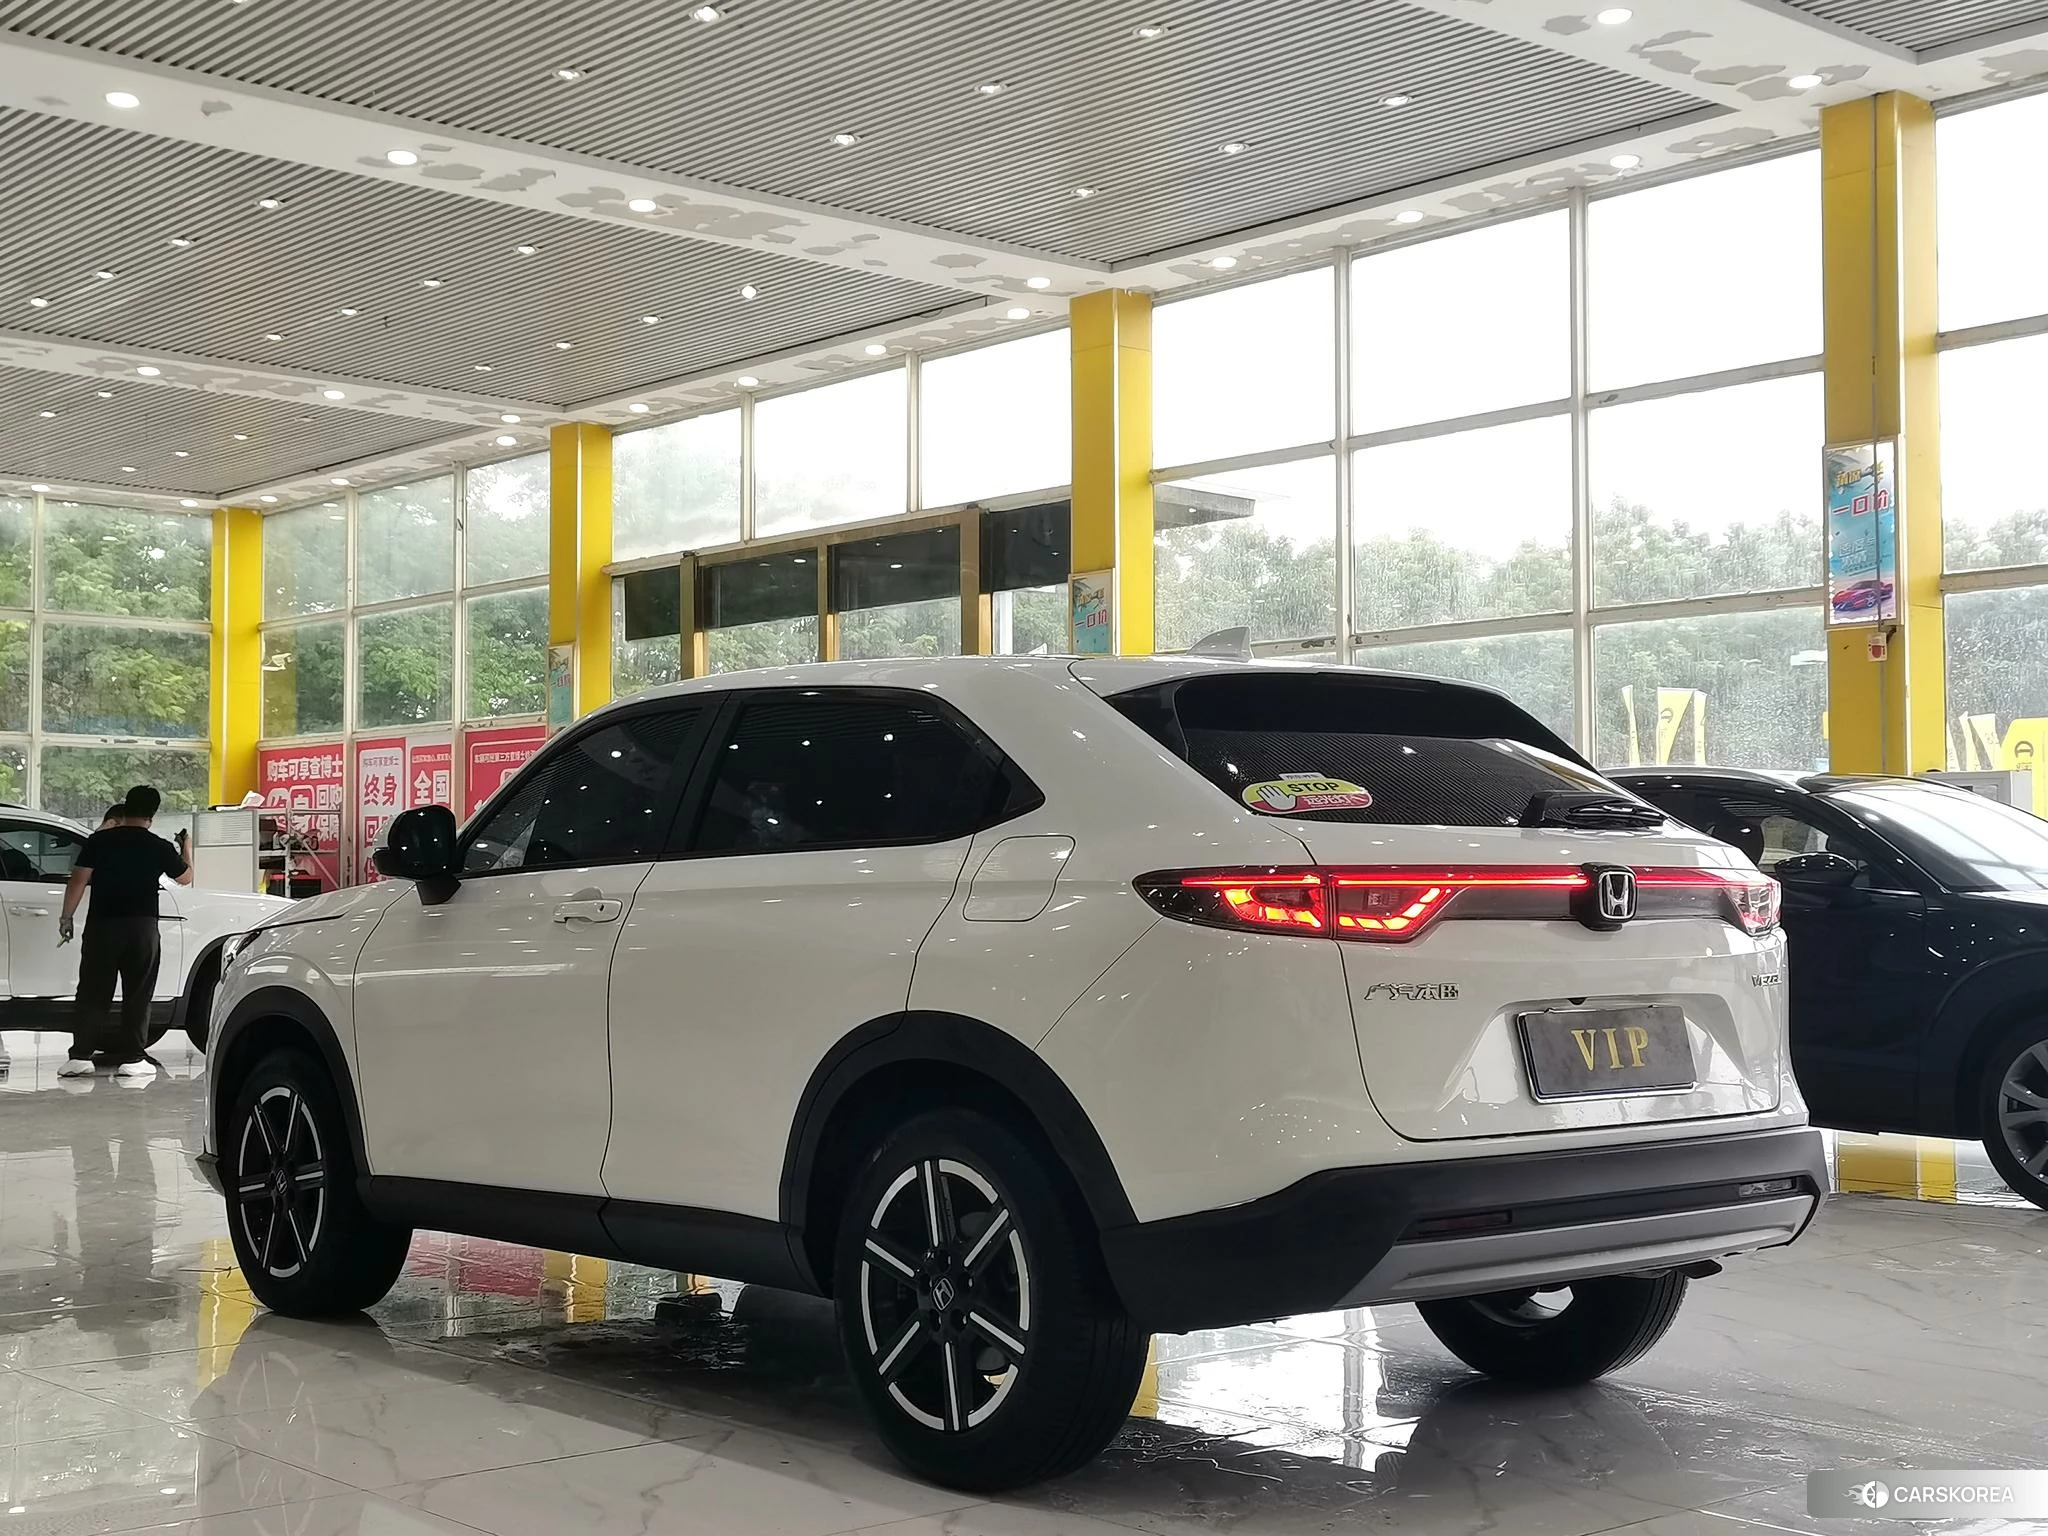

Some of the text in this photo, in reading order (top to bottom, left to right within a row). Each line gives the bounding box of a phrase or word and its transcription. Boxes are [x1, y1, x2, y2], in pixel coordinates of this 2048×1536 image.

[266, 753, 342, 782] 购车可享查博士
[364, 772, 397, 806] 终身
[1287, 782, 1339, 793] STOP
[1570, 1026, 1650, 1071] VIP
